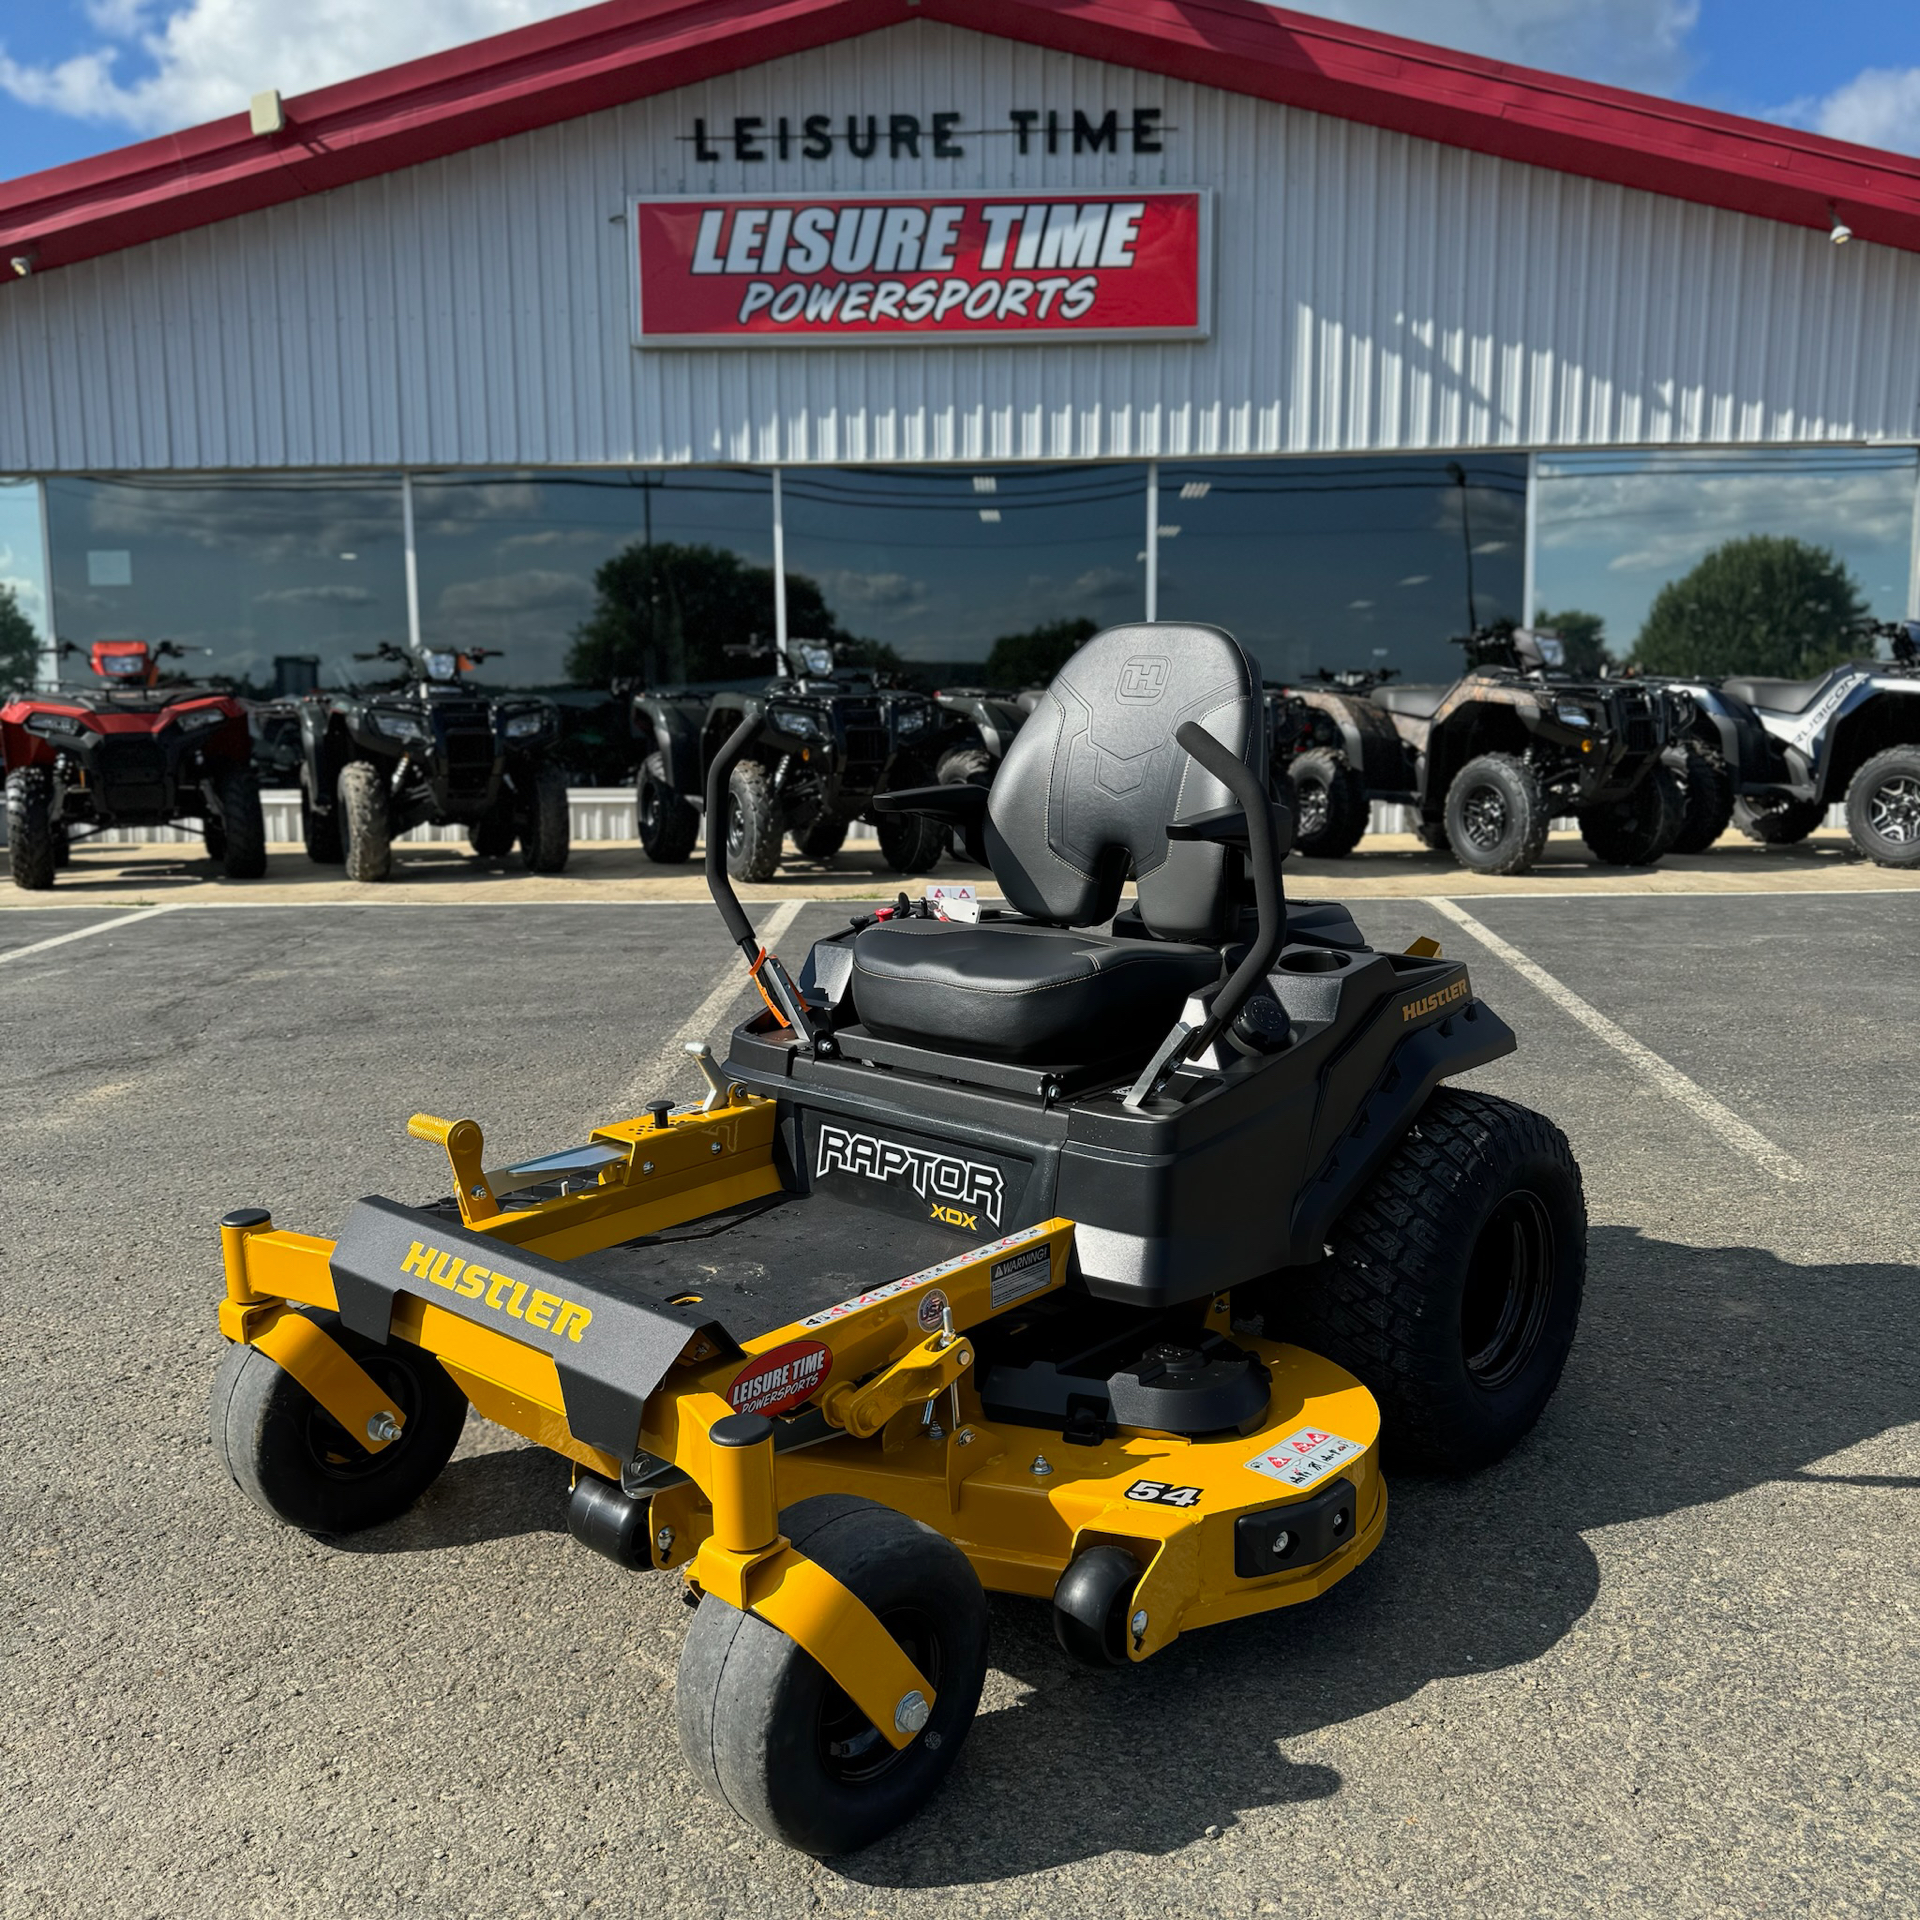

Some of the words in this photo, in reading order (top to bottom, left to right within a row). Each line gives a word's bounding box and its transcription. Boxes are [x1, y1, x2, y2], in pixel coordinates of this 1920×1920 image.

[694, 112, 964, 162] LEISURE
[1010, 108, 1162, 155] TIME
[690, 205, 966, 275] LEISURE
[979, 201, 1147, 271] TIME
[738, 275, 1099, 325] POWERSPORTS
[1793, 674, 1857, 743] RUBICON
[1402, 979, 1468, 1022] HUSTLER
[816, 1124, 1005, 1228] RAPTOR
[930, 1202, 978, 1231] XDX
[1003, 1246, 1048, 1275] WARNING!
[400, 1240, 593, 1344] HUSTLER
[732, 1364, 790, 1407] LEISURE
[792, 1349, 826, 1381] TIME
[741, 1372, 819, 1414] POWERSPORTS
[1127, 1481, 1201, 1508] 54
